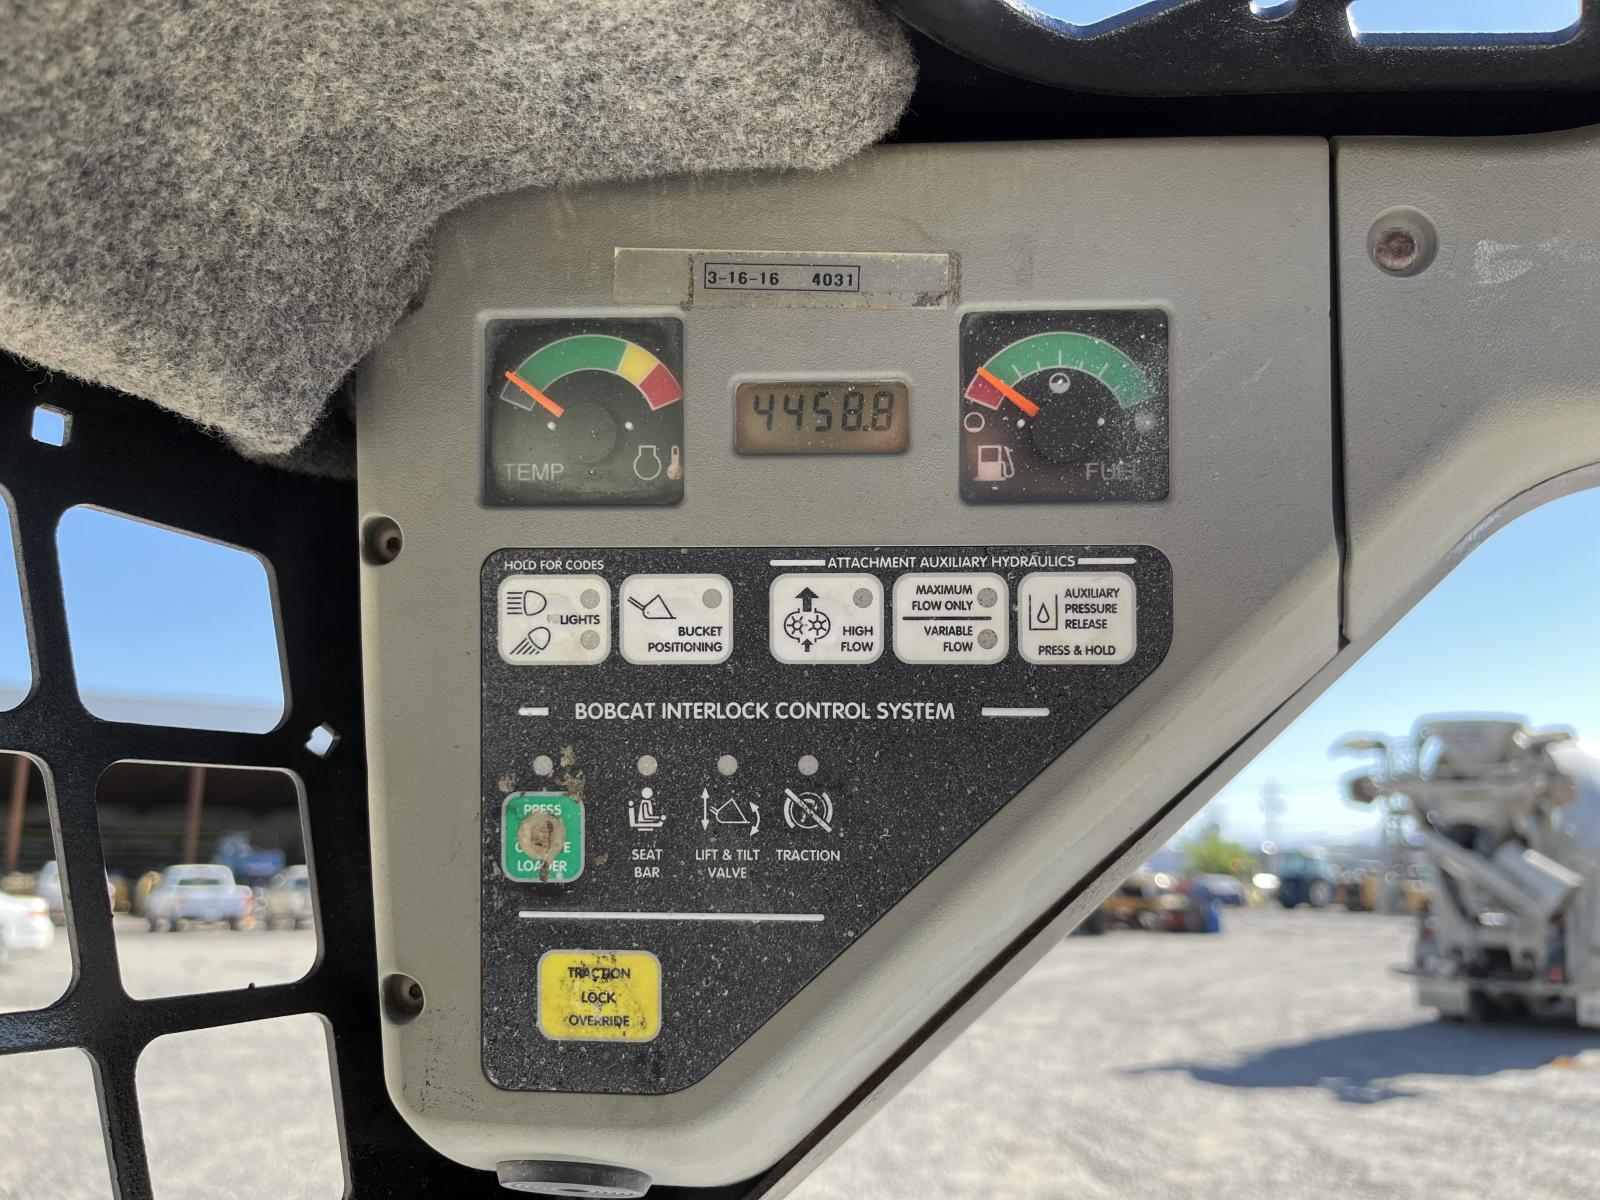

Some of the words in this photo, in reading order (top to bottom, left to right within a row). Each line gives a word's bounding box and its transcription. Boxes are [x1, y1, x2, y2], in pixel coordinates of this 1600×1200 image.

[707, 271, 780, 286] 3-16-16
[811, 273, 854, 287] 4031
[753, 391, 895, 433] 4458.8
[502, 463, 564, 481] TEMP
[504, 560, 537, 571] HOLD
[540, 560, 564, 571] FOR
[565, 560, 605, 571] CODES
[827, 556, 917, 569] ATTACHMENT
[919, 556, 988, 568] AUXILIARY
[991, 555, 1076, 568] HYDRAULICS
[915, 584, 973, 595] MAXIMUM
[1063, 588, 1120, 599] AUXILIARY
[912, 600, 942, 611] FLOW
[945, 600, 974, 611] ONLY
[1064, 603, 1118, 614] PRESSURE
[560, 614, 601, 625] LIGHTS
[1064, 618, 1108, 630] RELEASE
[678, 626, 723, 637] BUCKET
[842, 625, 874, 637] HIGH
[923, 625, 973, 637] VARIABLE
[648, 642, 723, 653] POSITIONING
[840, 641, 874, 653] FLOW
[943, 641, 973, 653] FLOW
[1038, 645, 1070, 656] PRESS
[1072, 645, 1083, 656] &
[1085, 644, 1116, 656] HOLD
[575, 702, 656, 720] BOBCAT
[662, 702, 769, 720] INTERLOCK
[775, 702, 871, 720] CONTROL
[876, 702, 955, 720] SYSTEM
[631, 849, 663, 861] SEAT
[695, 849, 720, 861] LIFT
[722, 849, 734, 861] &
[736, 849, 761, 861] TILT
[775, 850, 841, 861] TRACTION
[634, 866, 660, 878] BAR
[707, 867, 748, 879] VALVE
[568, 967, 631, 979] TRACTION
[581, 992, 617, 1004] LOCK
[568, 1014, 631, 1027] OVERRIDE
